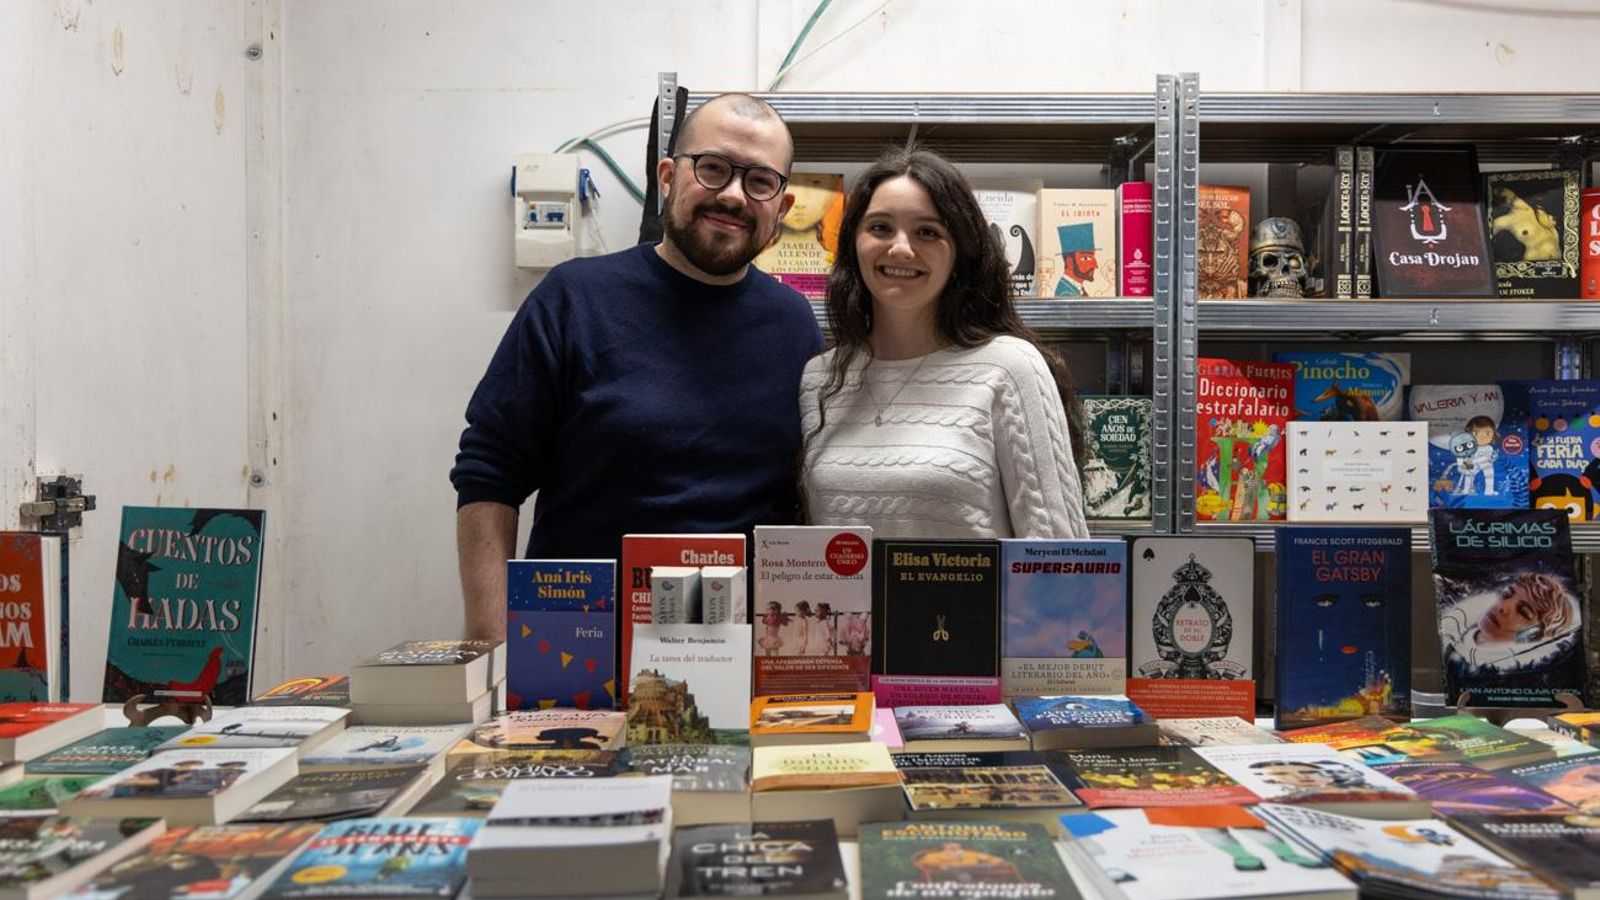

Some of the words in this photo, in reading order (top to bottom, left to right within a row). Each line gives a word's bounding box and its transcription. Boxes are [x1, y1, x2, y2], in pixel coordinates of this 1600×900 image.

[777, 250, 821, 258] ALLENDE
[1389, 252, 1423, 266] Casa
[1424, 251, 1479, 268] Drojan
[1200, 379, 1288, 400] Diccionario
[1196, 399, 1290, 416] estrafalario
[1414, 396, 1466, 413] VALERIA
[1468, 393, 1478, 403] Y
[1484, 391, 1500, 402] MI
[1108, 415, 1128, 424] CIEN
[1100, 433, 1137, 442] SOLEDAD
[1554, 435, 1584, 444] FUERA
[1536, 444, 1585, 459] FERIA
[1537, 459, 1563, 469] CADA
[1449, 518, 1557, 535] LÁGRIMAS
[128, 528, 254, 566] CUENTOS
[1294, 537, 1329, 546] FRANCIS
[1329, 537, 1356, 546] SCOTT
[1357, 537, 1403, 546] FITZGERALD
[1456, 535, 1484, 548] DE
[1488, 536, 1553, 548] SILICIO
[680, 549, 735, 565] Charles
[1024, 547, 1060, 558] Meryem
[1061, 547, 1070, 556] El
[1311, 550, 1330, 565] EL
[1336, 550, 1385, 565] GRAN
[761, 558, 784, 568] Rosa
[786, 558, 826, 568] Montero
[892, 552, 929, 567] Elisa
[931, 552, 991, 568] Victoria
[1011, 561, 1122, 574] SUPERSAURIO
[1316, 566, 1381, 582] GATSBY
[175, 573, 199, 589] DE
[531, 568, 563, 584] Ana
[565, 569, 593, 584] Iris
[761, 571, 770, 580] El
[771, 571, 801, 583] peligro
[804, 571, 813, 580] de
[900, 572, 914, 581] EL
[918, 572, 984, 582] EVANGELIO
[537, 584, 587, 600] Simón
[127, 598, 242, 633] HADAS
[1175, 619, 1210, 627] RETRATO
[575, 626, 604, 639] Feria
[1179, 634, 1205, 643] DOBLE
[659, 636, 685, 644] Walter
[687, 636, 726, 646] Benjamin
[651, 653, 660, 662] La
[683, 653, 696, 662] del
[698, 653, 734, 662] traductor
[1038, 663, 1070, 671] MEJOR
[1072, 663, 1105, 671] DEBUT
[1011, 671, 1063, 679] LITERARIO
[1065, 671, 1084, 679] DEL
[628, 757, 736, 766] CATEDRAL
[650, 765, 710, 773] MAR
[734, 831, 771, 840] LA
[691, 841, 814, 854] CHICA
[696, 864, 804, 878] TREN
